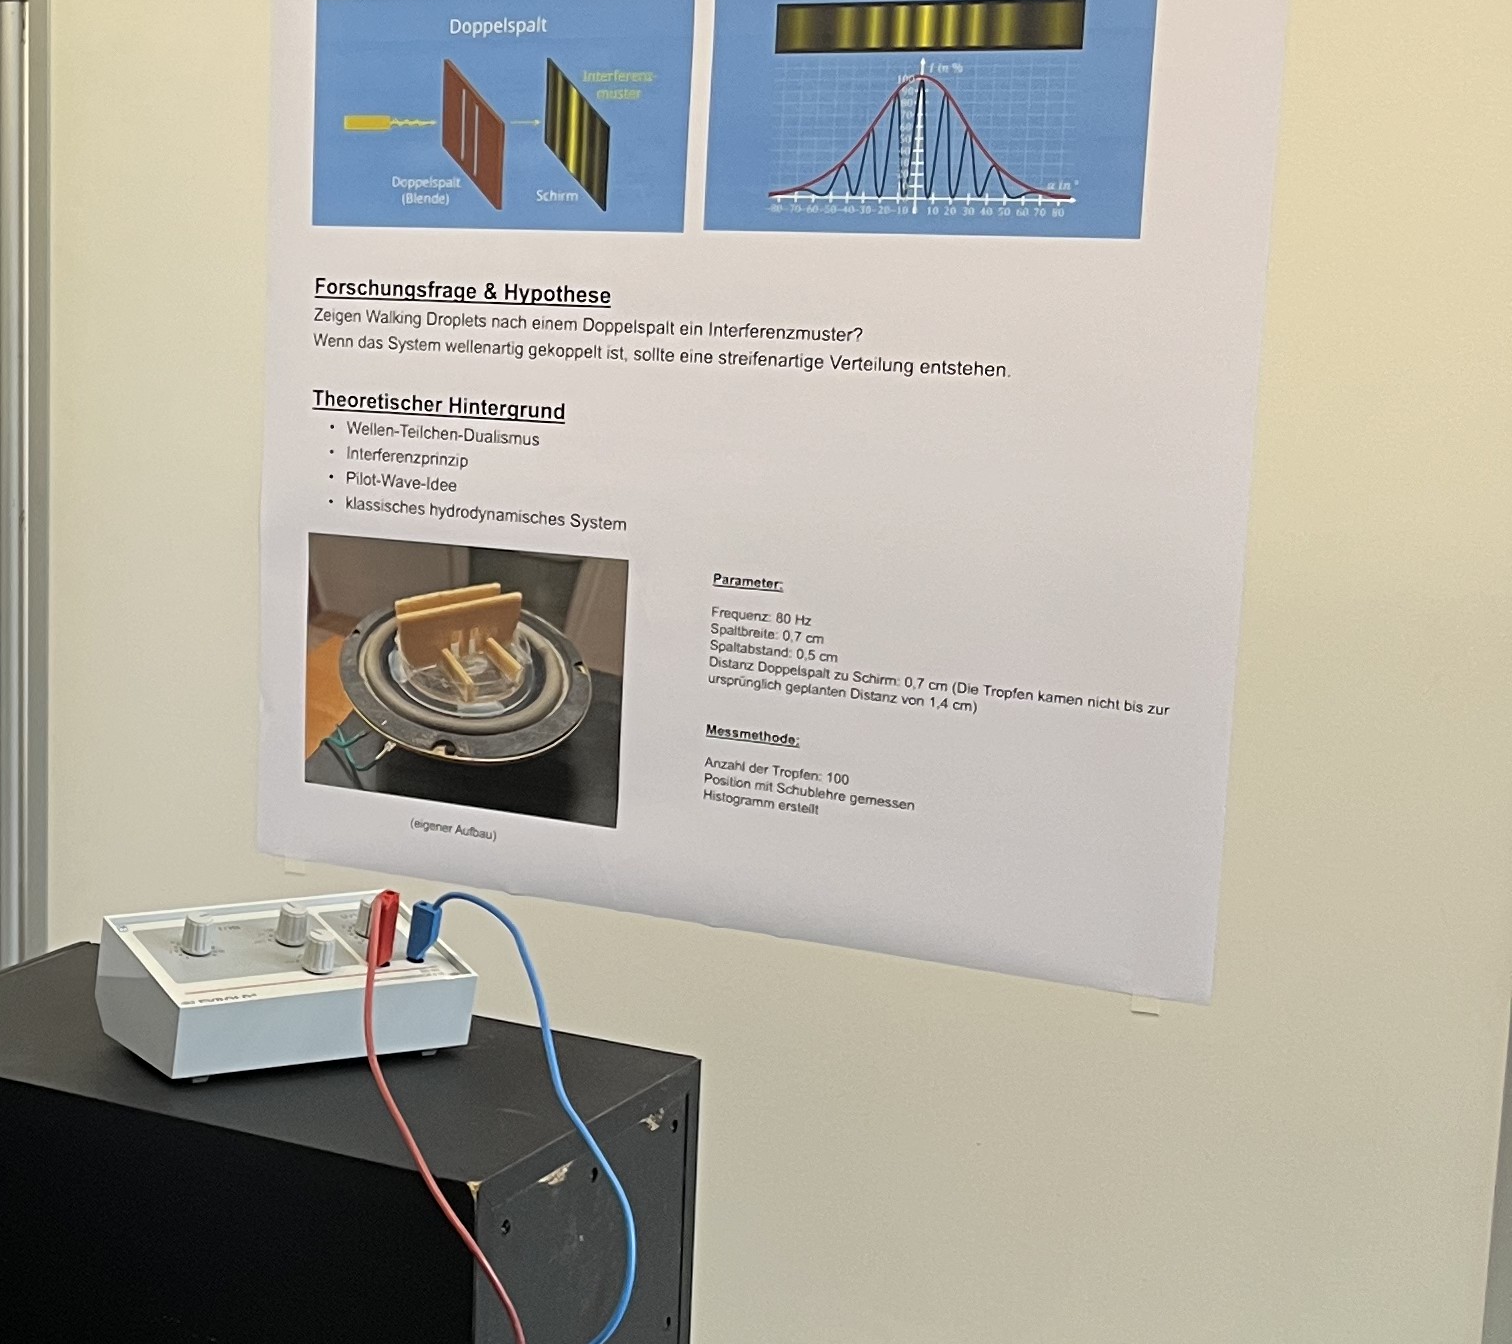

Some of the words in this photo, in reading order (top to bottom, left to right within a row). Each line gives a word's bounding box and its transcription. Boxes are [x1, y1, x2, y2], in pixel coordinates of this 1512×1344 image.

[448, 17, 548, 38] Doppelspalt
[596, 87, 643, 101] muster
[391, 176, 462, 191] Doppelspalt
[535, 189, 579, 203] Schirm
[401, 192, 450, 206] (Blende)
[314, 277, 477, 302] Forschungsfrage
[483, 282, 498, 301] &
[504, 283, 612, 306] Hypothese
[313, 307, 362, 327] Zeigen
[365, 309, 422, 329] Walking
[426, 311, 487, 331] Droplets
[491, 314, 527, 330] nach
[531, 315, 578, 332] einem
[582, 316, 675, 339] Doppelspalt
[679, 320, 703, 337] ein
[708, 321, 864, 343] Interferenzmuster?
[312, 389, 444, 414] Theoretischer
[448, 396, 566, 422] Hintergrund
[346, 420, 540, 447] Wellen-Teilchen-Dualismus
[346, 445, 469, 471] Interferenzprinzip
[345, 470, 458, 493] Pilot-Wave-Idee
[345, 495, 426, 516] klassisches
[429, 501, 566, 527] hydrodynamisches
[569, 512, 627, 533] System
[712, 572, 784, 591] Parameter:
[711, 605, 772, 623] Frequenz:
[775, 611, 792, 625] 80
[794, 613, 813, 627] Hz
[710, 622, 779, 641] Spaltbreite:
[782, 629, 803, 644] 0,7
[805, 634, 825, 645] cm
[709, 639, 793, 659] Spaltabstand:
[795, 647, 816, 662] 0,5
[818, 652, 839, 663] cm
[709, 655, 755, 672] Distanz
[757, 660, 831, 680] Doppelspalt
[833, 671, 849, 682] zu
[852, 670, 901, 687] Schirm:
[904, 676, 925, 691] 0,7
[928, 681, 949, 693] cm
[951, 681, 979, 697] (Die
[982, 683, 1034, 702] Tropfen
[1037, 689, 1083, 707] kamen
[1087, 695, 1120, 711] nicht
[1123, 699, 1144, 714] bis
[1146, 704, 1171, 716] zur
[705, 723, 801, 746] Messmethode:
[703, 756, 746, 773] Anzahl
[748, 762, 769, 775] der
[771, 764, 823, 782] Tropfen:
[826, 771, 850, 786] 100
[702, 788, 775, 810] Histogramm
[777, 801, 819, 816] erstellt
[703, 772, 752, 790] Position
[753, 781, 773, 793] mit
[776, 781, 847, 802] Schublehre
[849, 794, 915, 811] gemessen
[409, 816, 454, 835] (eigener
[455, 824, 498, 842] Aufbau)
